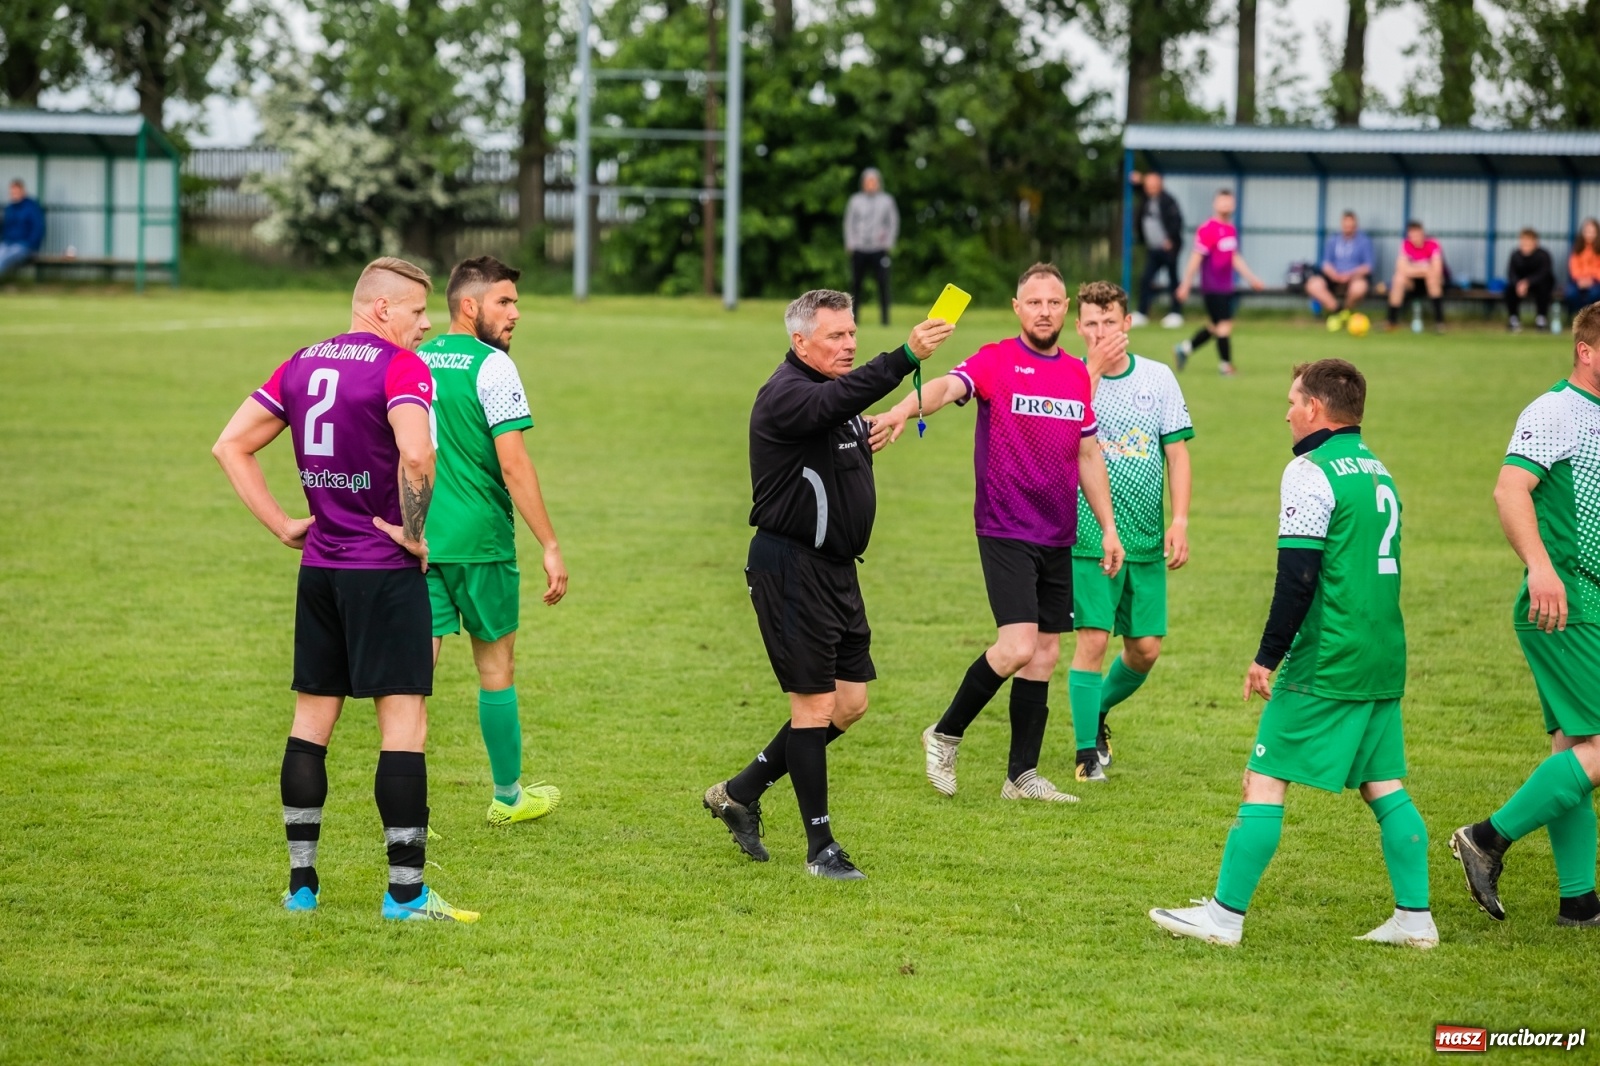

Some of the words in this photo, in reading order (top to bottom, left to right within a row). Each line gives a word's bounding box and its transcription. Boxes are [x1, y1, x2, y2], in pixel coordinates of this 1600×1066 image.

[317, 342, 383, 363] BOJANÓW
[304, 368, 339, 456] 2
[1329, 457, 1359, 476] LKS
[1376, 484, 1399, 574] 2
